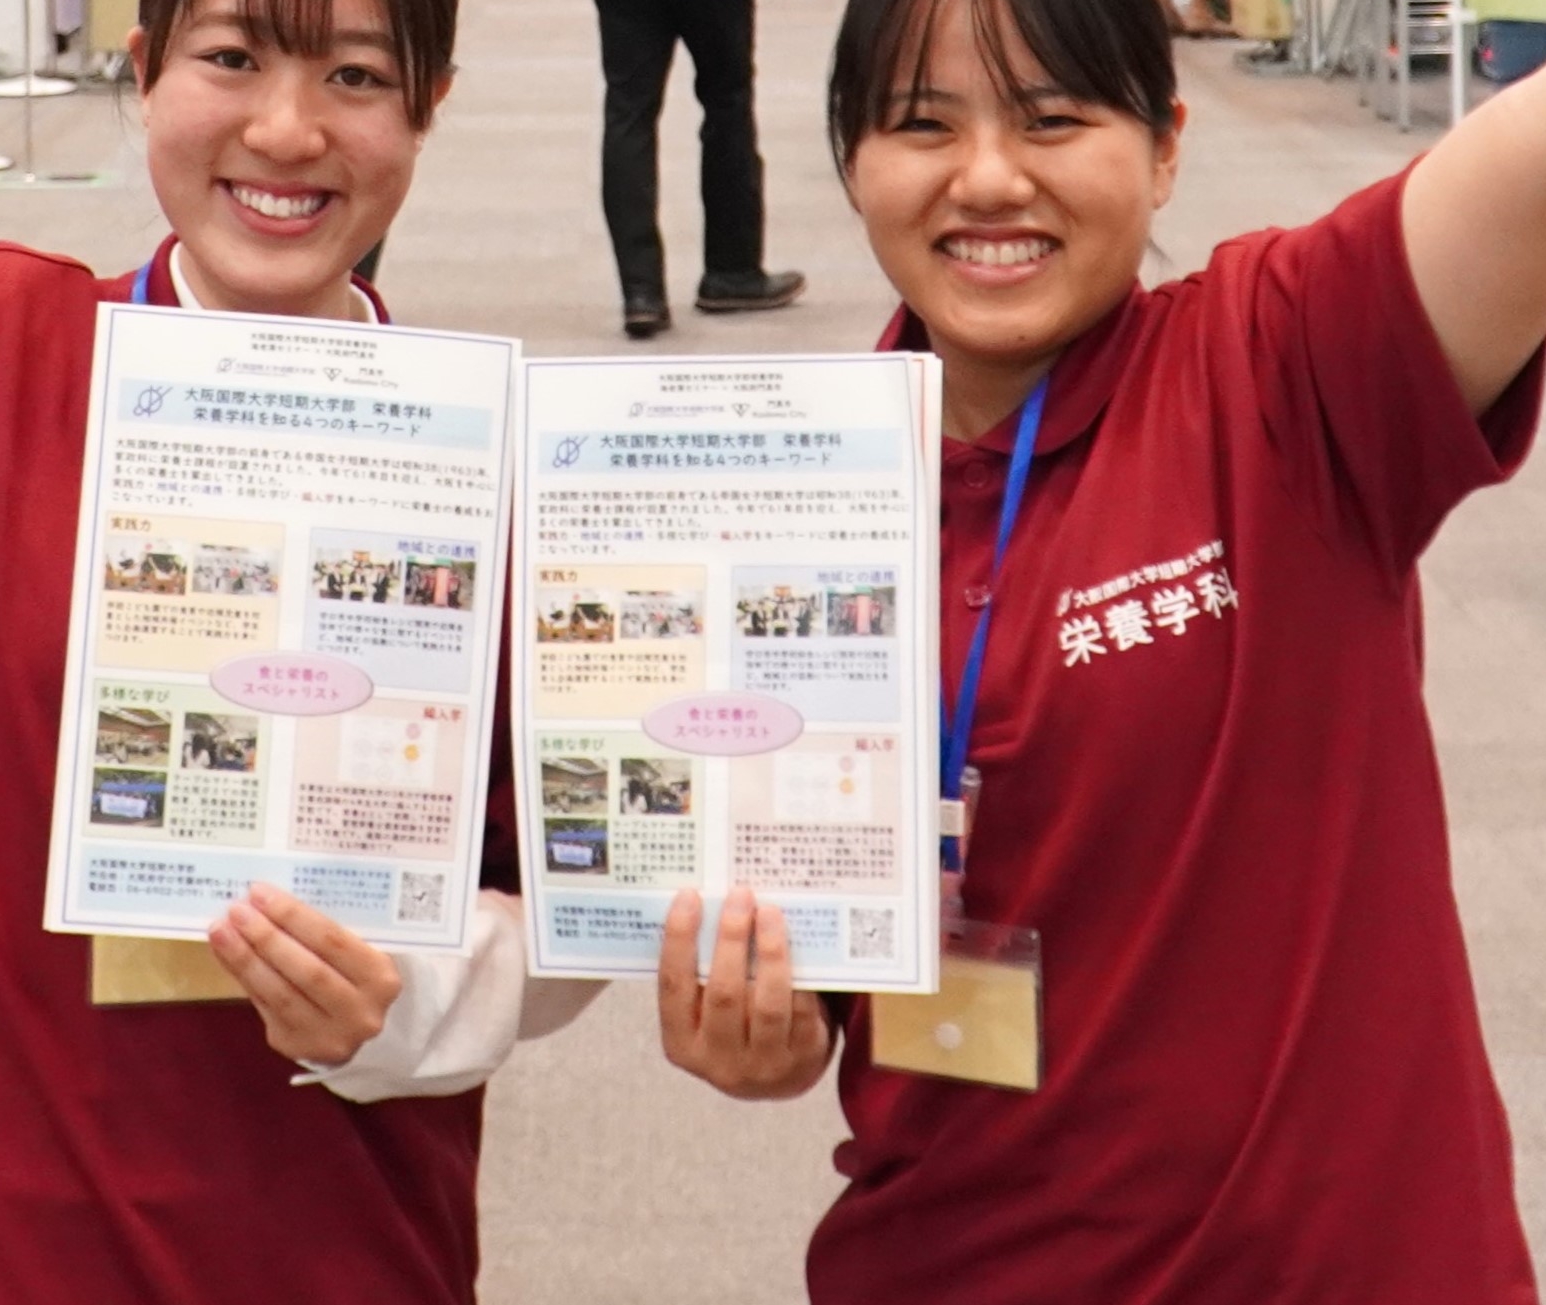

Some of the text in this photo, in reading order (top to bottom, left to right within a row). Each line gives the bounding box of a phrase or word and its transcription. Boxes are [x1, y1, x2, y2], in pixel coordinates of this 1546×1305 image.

[184, 387, 432, 420] 大阪国際大学短期大学部 栄養学科
[193, 407, 421, 437] 栄養学科を知る4つのキーワード
[599, 433, 842, 449] 大阪国際大学短期大学部 栄養学科
[610, 452, 833, 468] 栄養学科を知る4つのキーワード
[111, 515, 152, 532] 実践力
[398, 541, 476, 558] 地域との連携
[539, 569, 578, 582] 実践力
[817, 570, 896, 583] 地域との連携
[1059, 566, 1240, 668] 栄養学科
[259, 665, 328, 682] 食と栄養の
[99, 686, 170, 703] 多様な学び
[242, 682, 339, 701] スペシャリスト
[423, 707, 462, 721] 編入学
[675, 725, 771, 739] スペシャリスト
[539, 736, 606, 751] 多様な学び
[855, 738, 894, 752] 編入学
